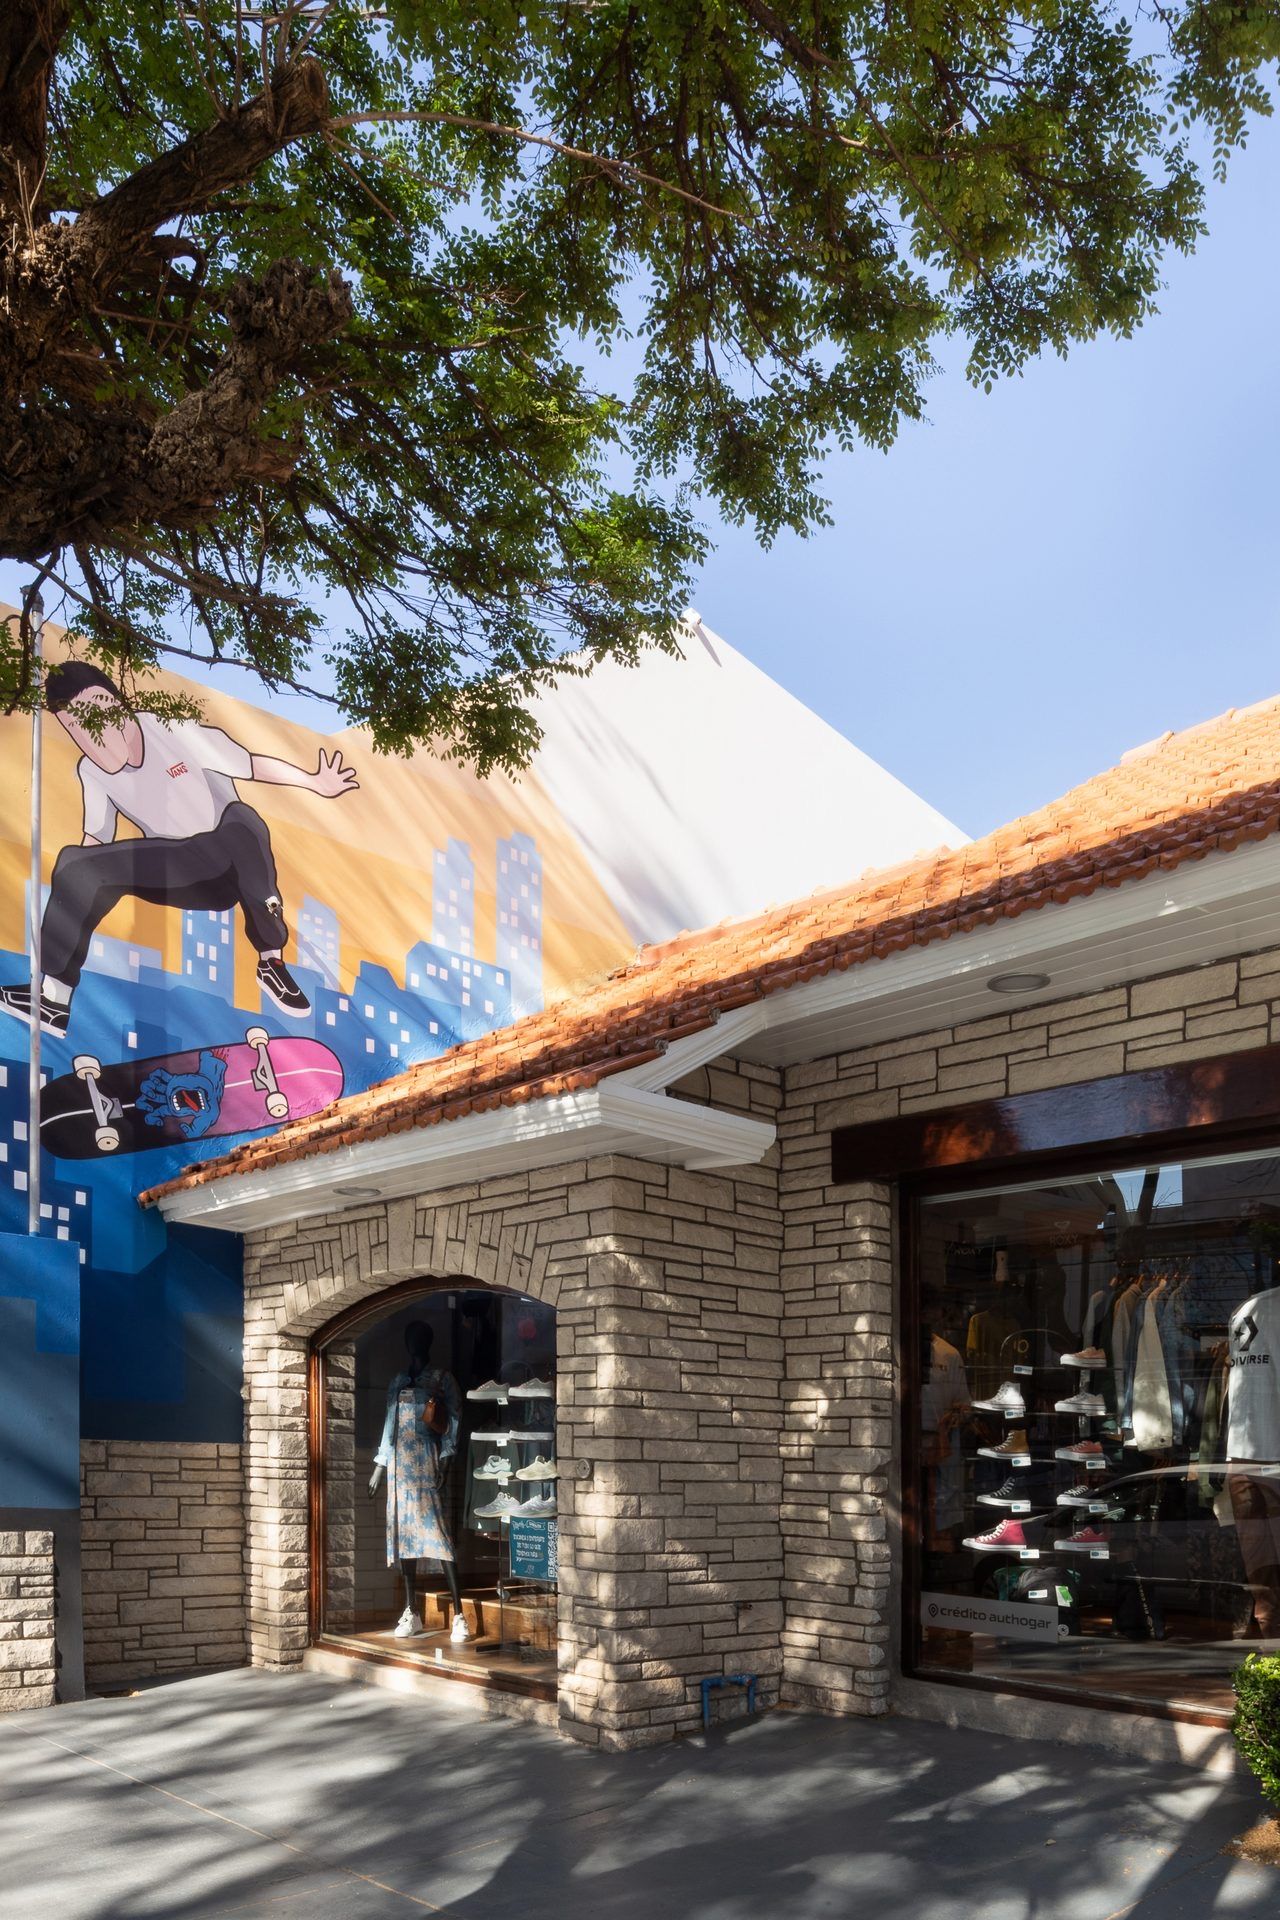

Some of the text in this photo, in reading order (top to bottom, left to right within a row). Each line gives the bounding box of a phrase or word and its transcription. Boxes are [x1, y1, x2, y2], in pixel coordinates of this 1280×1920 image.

[165, 761, 189, 779] VANS
[940, 1606, 1052, 1630] crédito authogar
